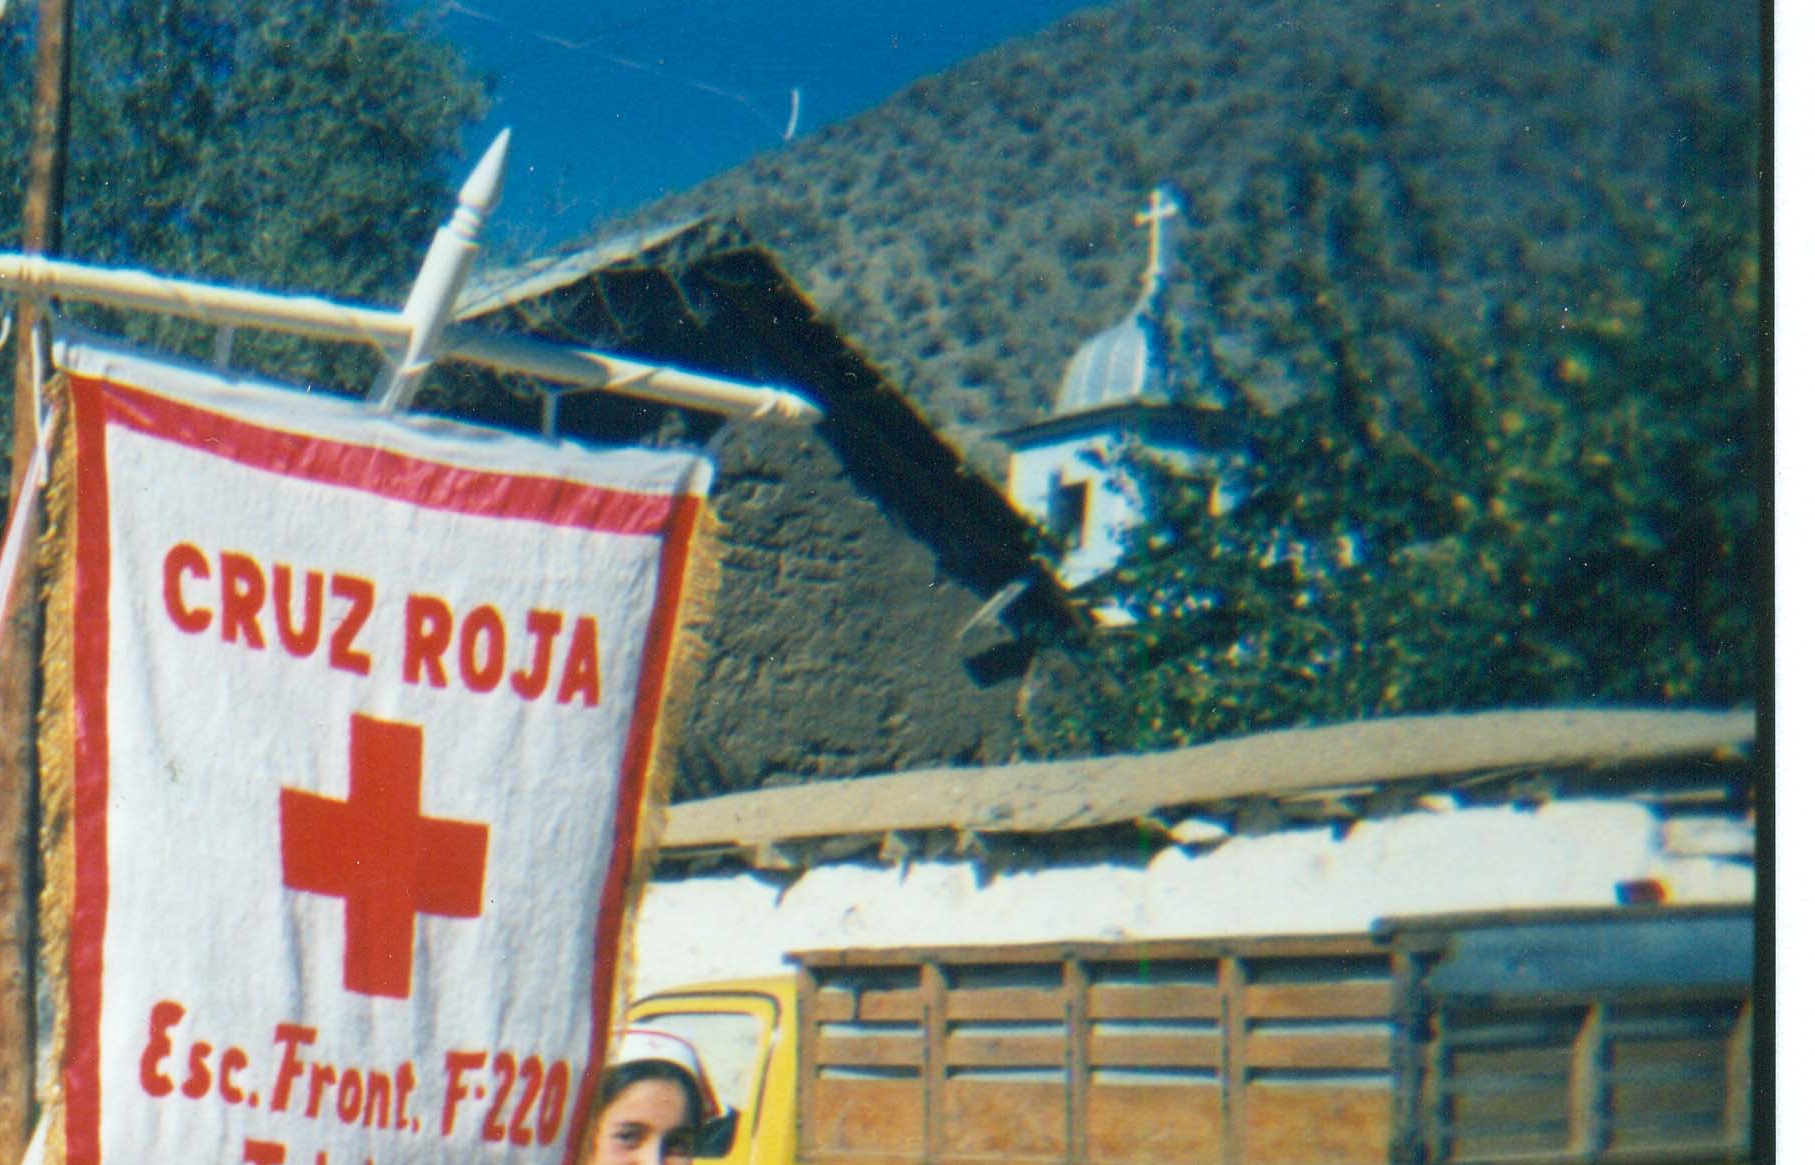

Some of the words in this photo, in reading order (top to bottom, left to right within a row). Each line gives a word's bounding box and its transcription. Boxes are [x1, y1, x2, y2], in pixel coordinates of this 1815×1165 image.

[162, 543, 375, 677] CRUZ
[402, 594, 601, 707] ROJA
[139, 1000, 259, 1111] Esc.
[270, 1023, 419, 1133] Front.
